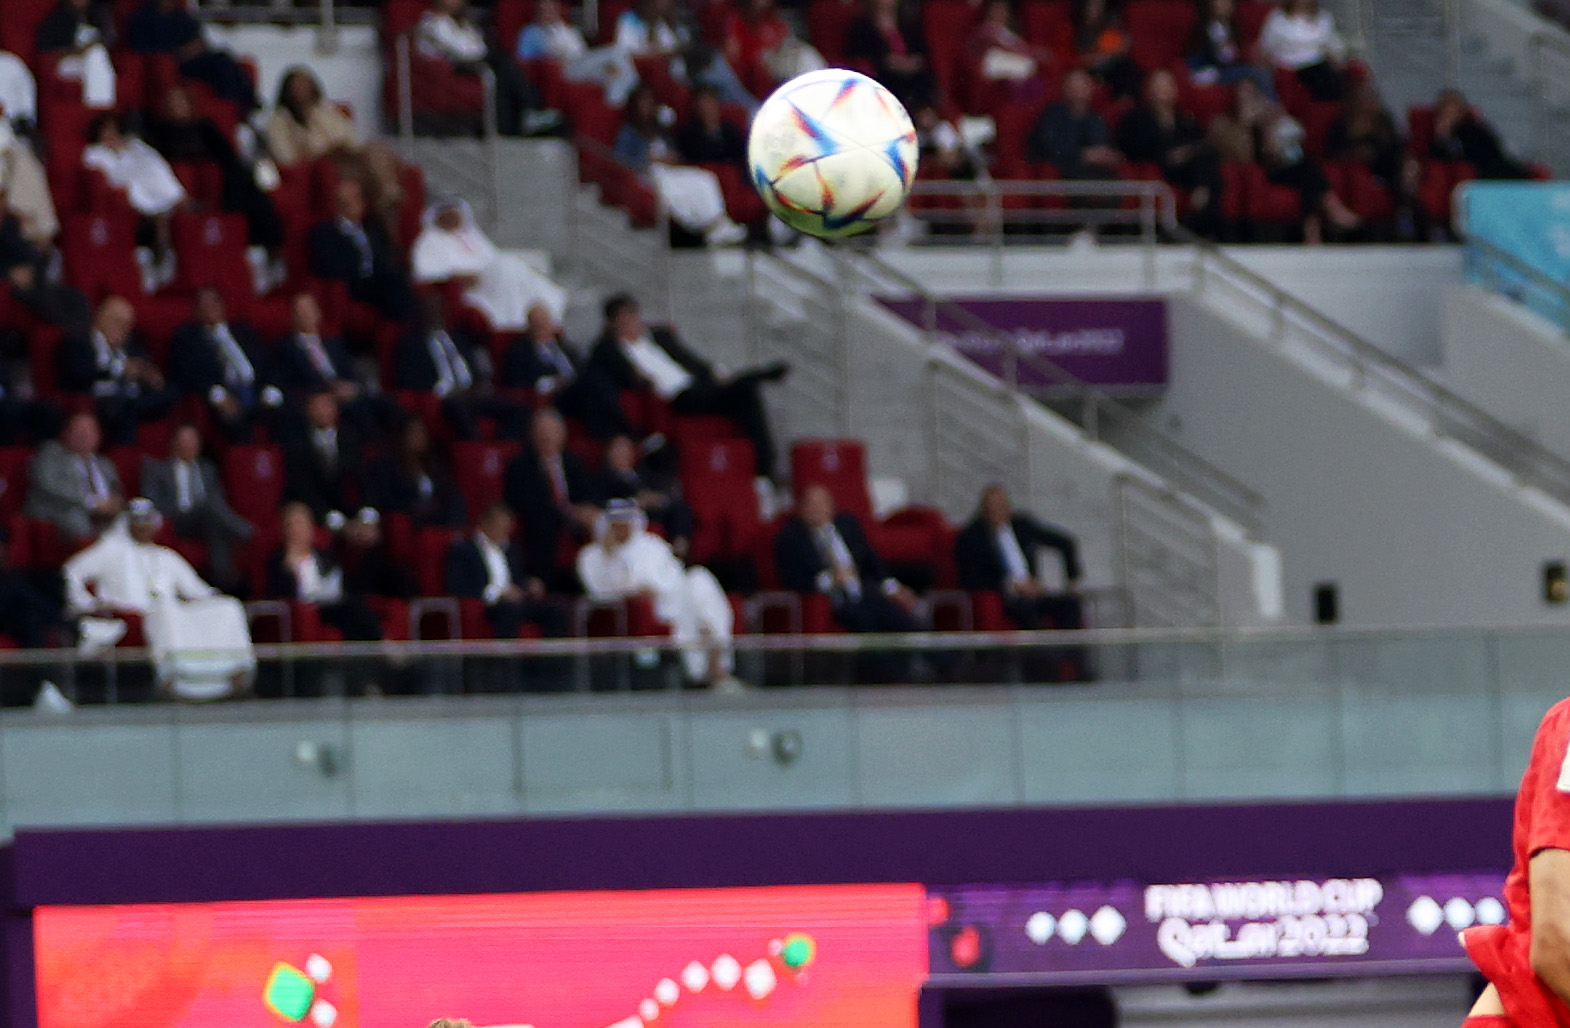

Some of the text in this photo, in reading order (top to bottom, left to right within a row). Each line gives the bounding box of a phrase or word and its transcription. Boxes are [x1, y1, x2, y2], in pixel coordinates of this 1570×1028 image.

[1144, 878, 1383, 922] FIFA WORLD CUP
